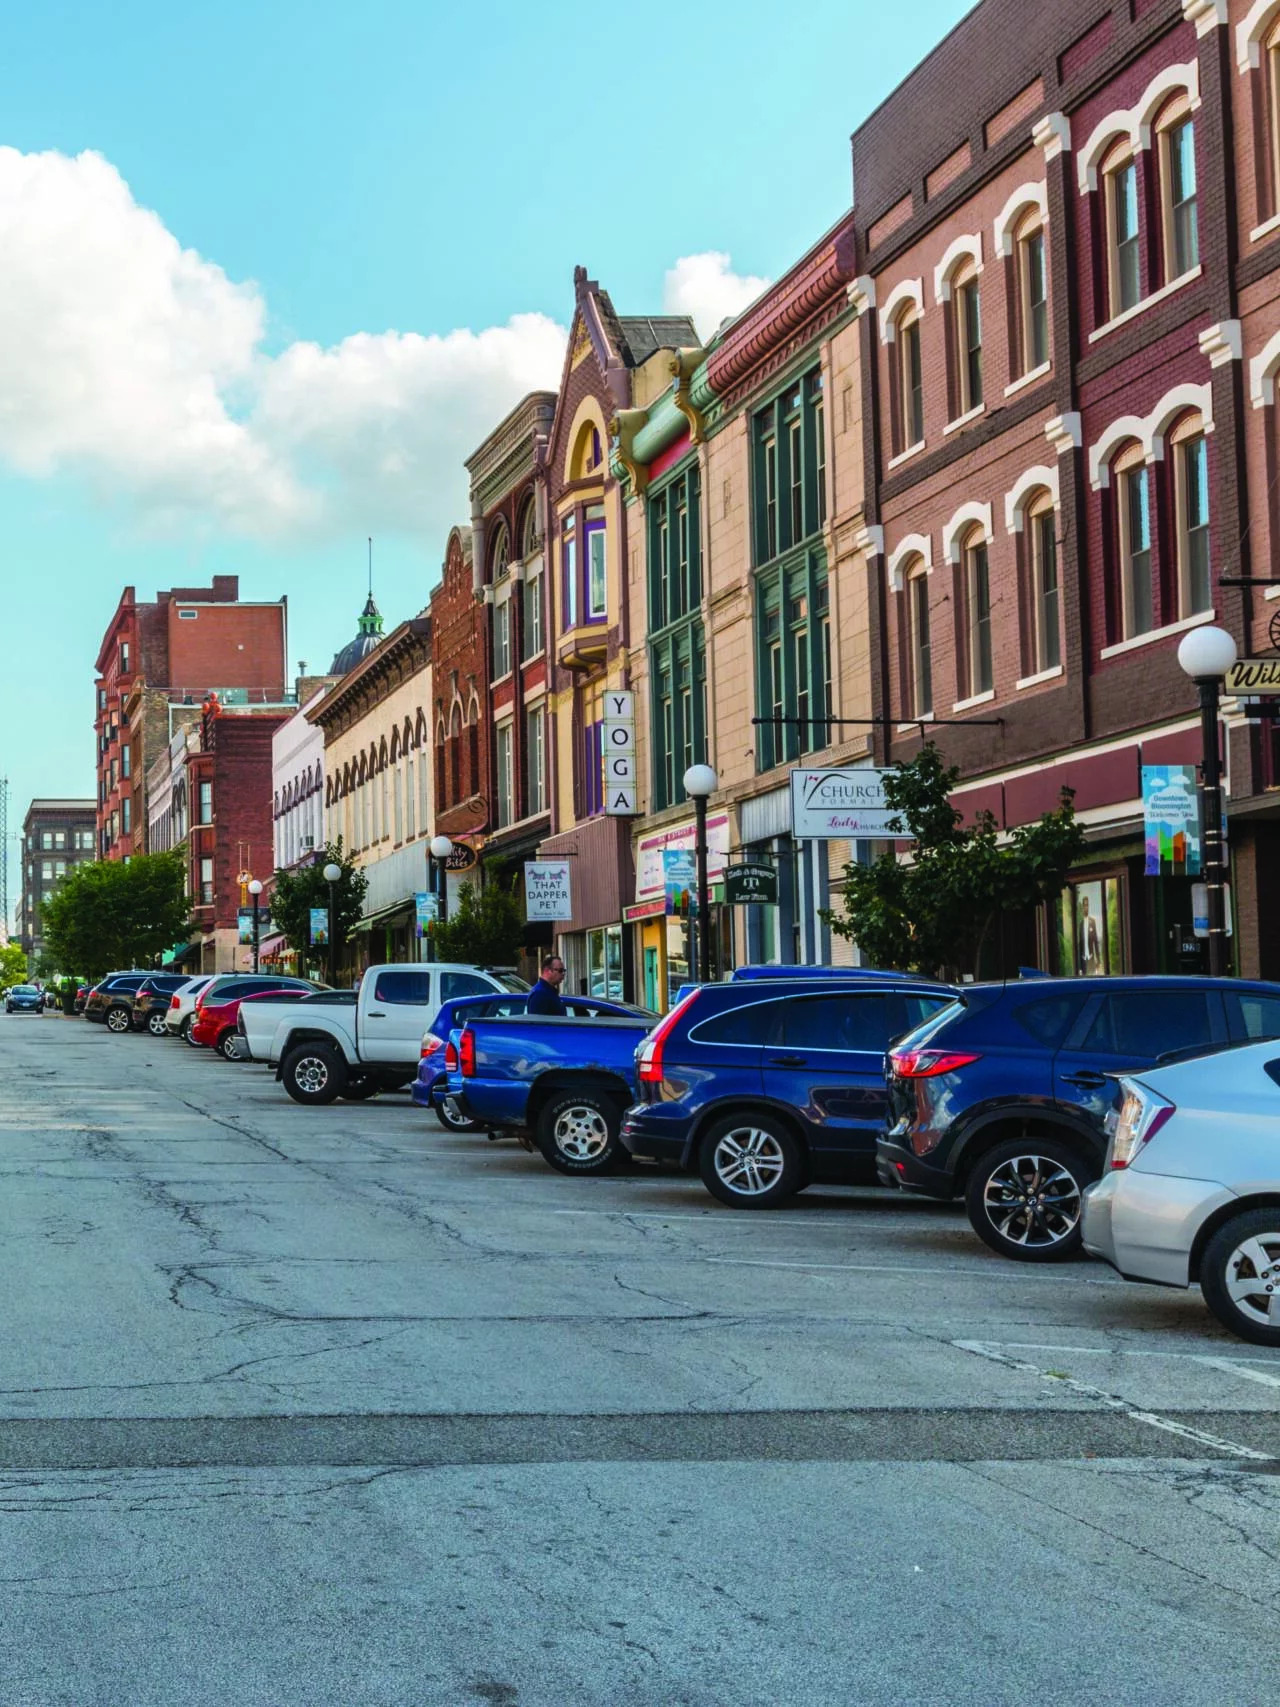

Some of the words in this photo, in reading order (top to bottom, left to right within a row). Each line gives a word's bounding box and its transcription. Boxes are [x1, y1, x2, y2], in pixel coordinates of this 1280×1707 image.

[611, 697, 630, 808] YOGA
[1151, 802, 1191, 811] Bloomington
[827, 816, 859, 830] Lady
[534, 881, 562, 889] THAT
[528, 890, 568, 899] DAPPER
[735, 893, 750, 901] Law
[751, 893, 769, 901] Firm
[539, 900, 561, 909] PET
